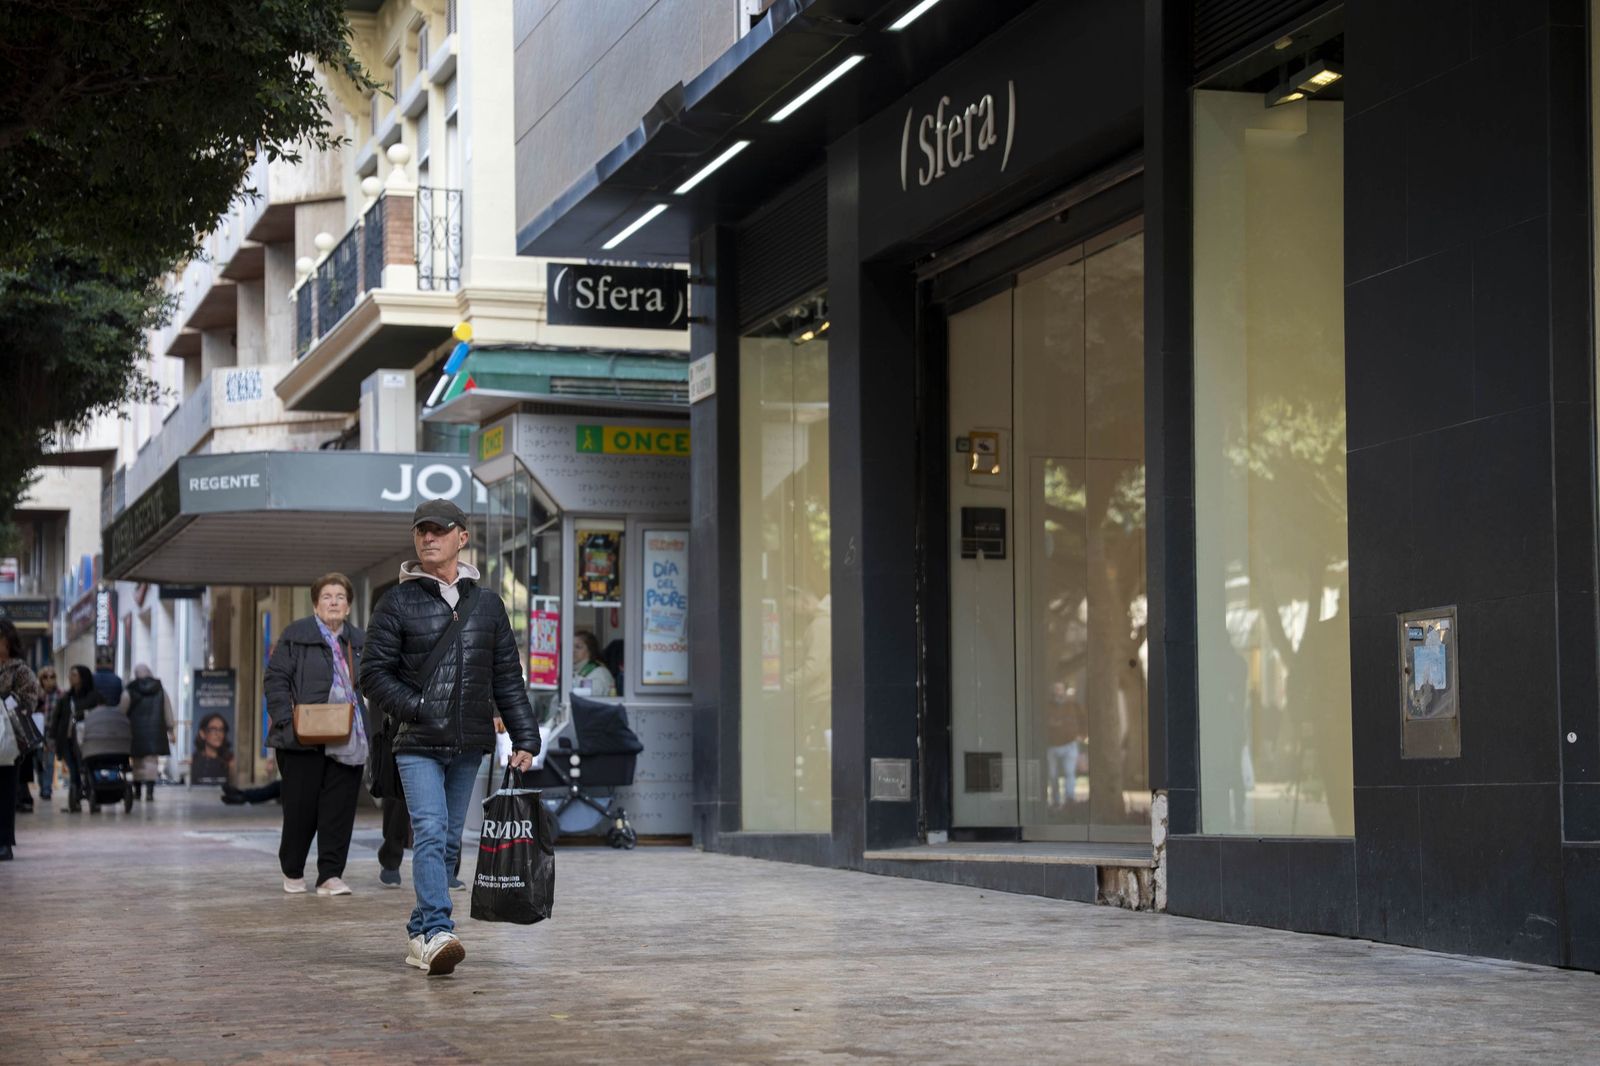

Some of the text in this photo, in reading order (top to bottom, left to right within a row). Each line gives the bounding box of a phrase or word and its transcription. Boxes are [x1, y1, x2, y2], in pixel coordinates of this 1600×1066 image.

[485, 429, 502, 456] ONCE
[613, 431, 689, 453] ONCE
[188, 473, 261, 492] REGENTE
[652, 559, 680, 578] DÍA
[656, 578, 677, 590] DEL
[646, 588, 688, 610] PADRE
